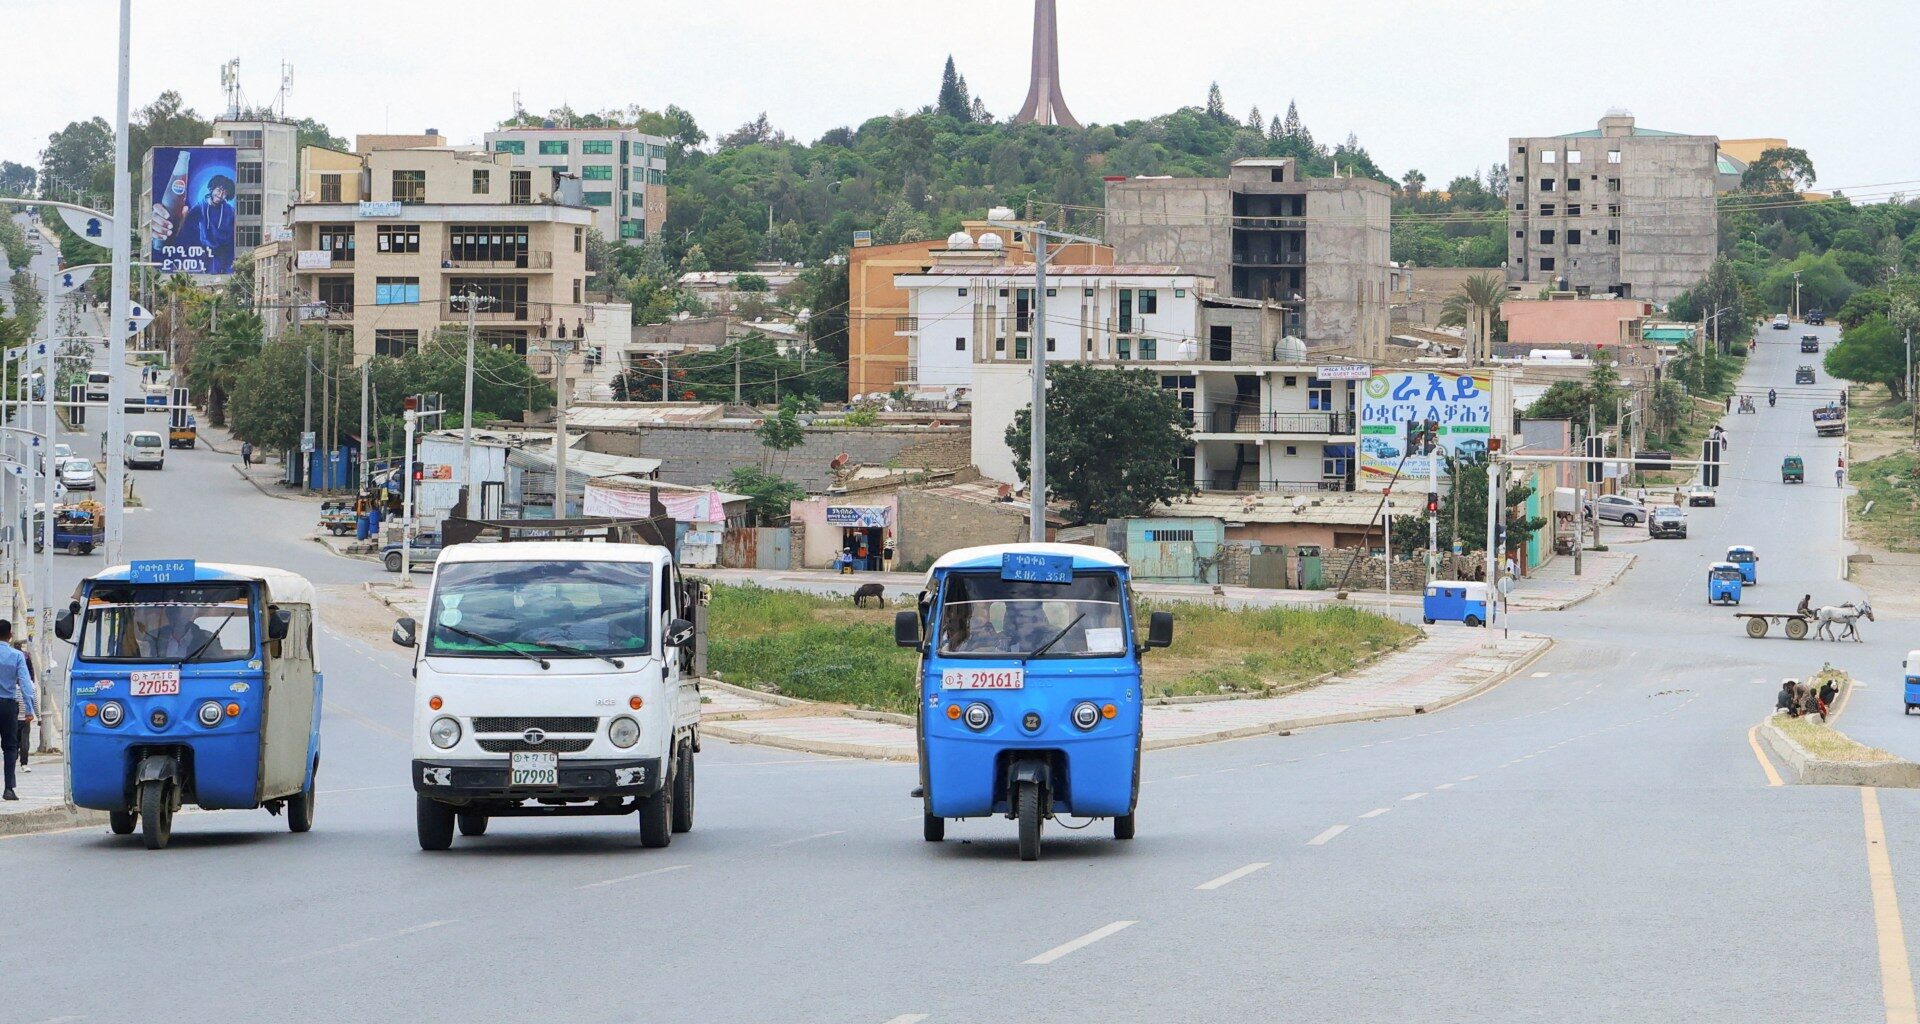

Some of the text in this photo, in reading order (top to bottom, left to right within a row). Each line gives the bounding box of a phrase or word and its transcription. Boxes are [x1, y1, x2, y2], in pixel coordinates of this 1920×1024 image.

[163, 245, 214, 257] ጥዒሙኒ
[1393, 373, 1479, 402] ራእይ
[153, 573, 170, 582] 101
[1045, 572, 1065, 582] 358
[139, 680, 177, 694] 27053
[972, 673, 1011, 688] 29161
[514, 769, 554, 783] 07998
